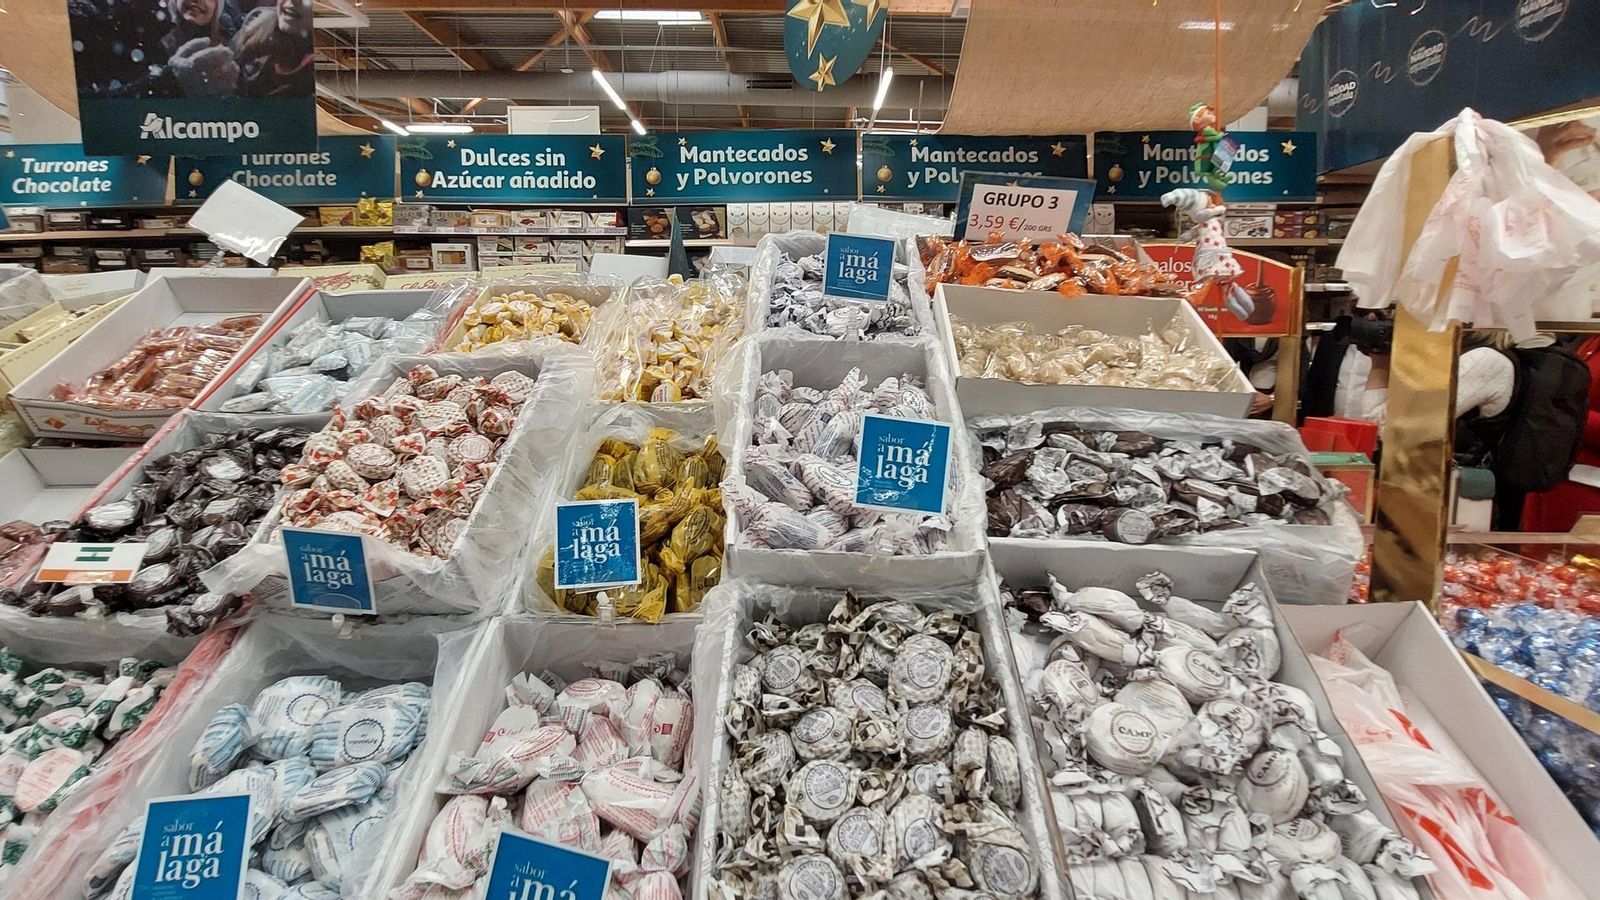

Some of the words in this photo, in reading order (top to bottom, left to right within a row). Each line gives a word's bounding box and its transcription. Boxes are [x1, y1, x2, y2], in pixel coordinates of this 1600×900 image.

[140, 112, 260, 143] Alcampo
[460, 148, 531, 167] Dulces
[536, 147, 566, 167] sin
[679, 144, 809, 164] Mantecados
[911, 146, 1039, 163] Mantecados
[1143, 144, 1270, 162] Mantdos
[21, 157, 109, 174] Turrones
[12, 176, 112, 194] Chocolate
[232, 169, 337, 187] Chocolate
[431, 170, 503, 189] Azúcar
[509, 169, 596, 189] añadido
[676, 173, 690, 190] y
[694, 167, 813, 186] Polvorones
[907, 171, 921, 189] y
[1138, 170, 1152, 189] y
[1156, 166, 1273, 185] Polvones
[983, 192, 1045, 209] GRUPO
[1048, 196, 1059, 210] 3
[969, 213, 1005, 230] 3,59
[1038, 224, 1053, 232] GRS
[846, 251, 880, 270] má
[838, 261, 879, 285] laga
[877, 443, 885, 453] a
[886, 441, 931, 467] má
[875, 454, 929, 488] laga
[580, 518, 622, 543] má
[301, 552, 308, 560] a
[310, 550, 353, 572] má
[572, 538, 622, 564] laga
[303, 562, 355, 590] laga
[162, 819, 195, 833] sabor
[160, 834, 170, 848] a
[170, 820, 225, 858] má
[154, 850, 222, 890] laga
[513, 860, 547, 879] sabor
[510, 873, 520, 888] a
